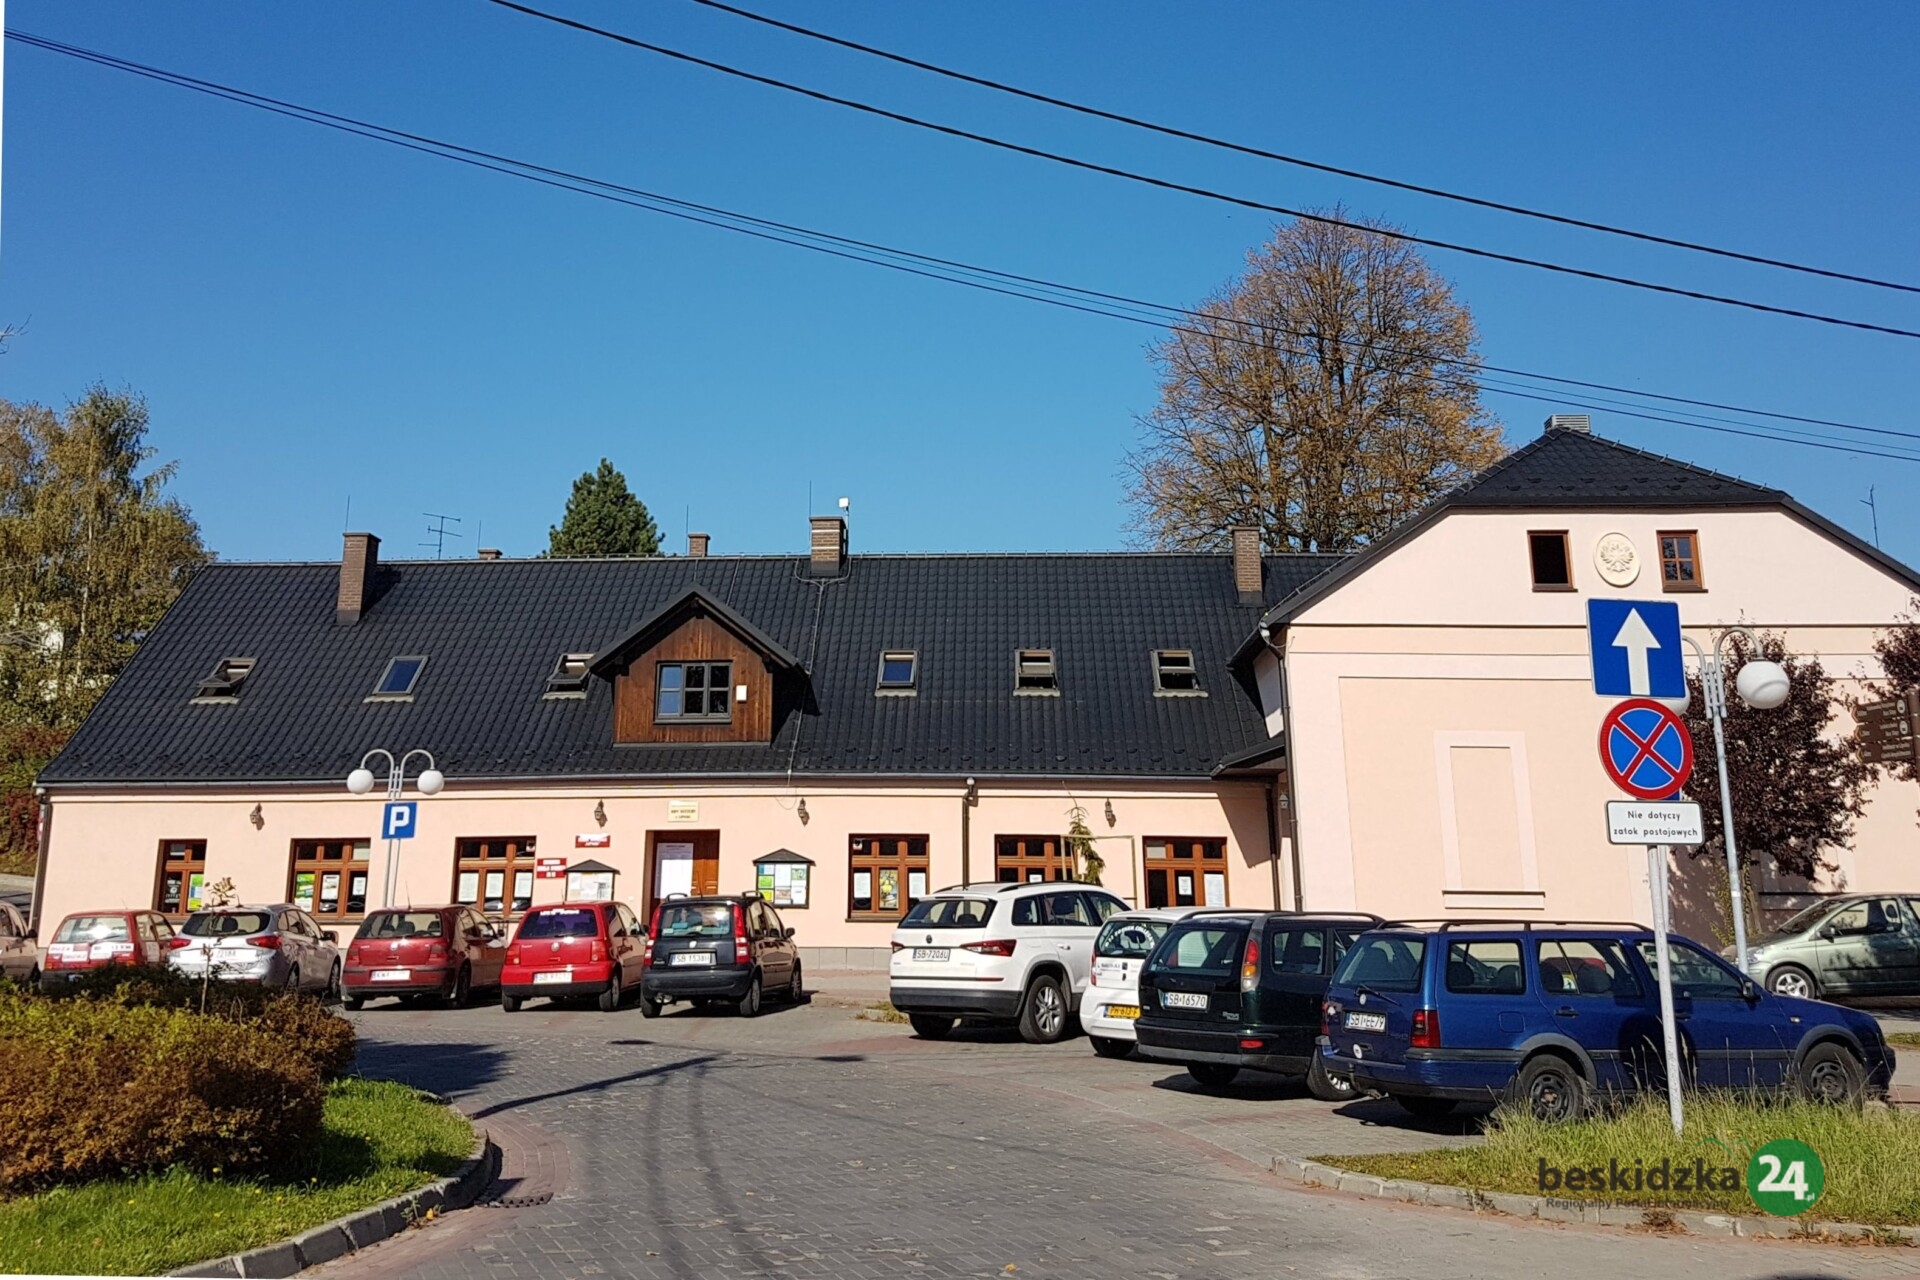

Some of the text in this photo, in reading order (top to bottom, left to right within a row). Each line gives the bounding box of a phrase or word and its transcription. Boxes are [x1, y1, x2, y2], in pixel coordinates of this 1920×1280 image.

[389, 806, 410, 835] P
[1627, 810, 1681, 821] Nie dotyczy
[1613, 827, 1698, 838] zatok postojowych
[917, 949, 926, 959] SB
[1168, 993, 1206, 1007] SB 16570
